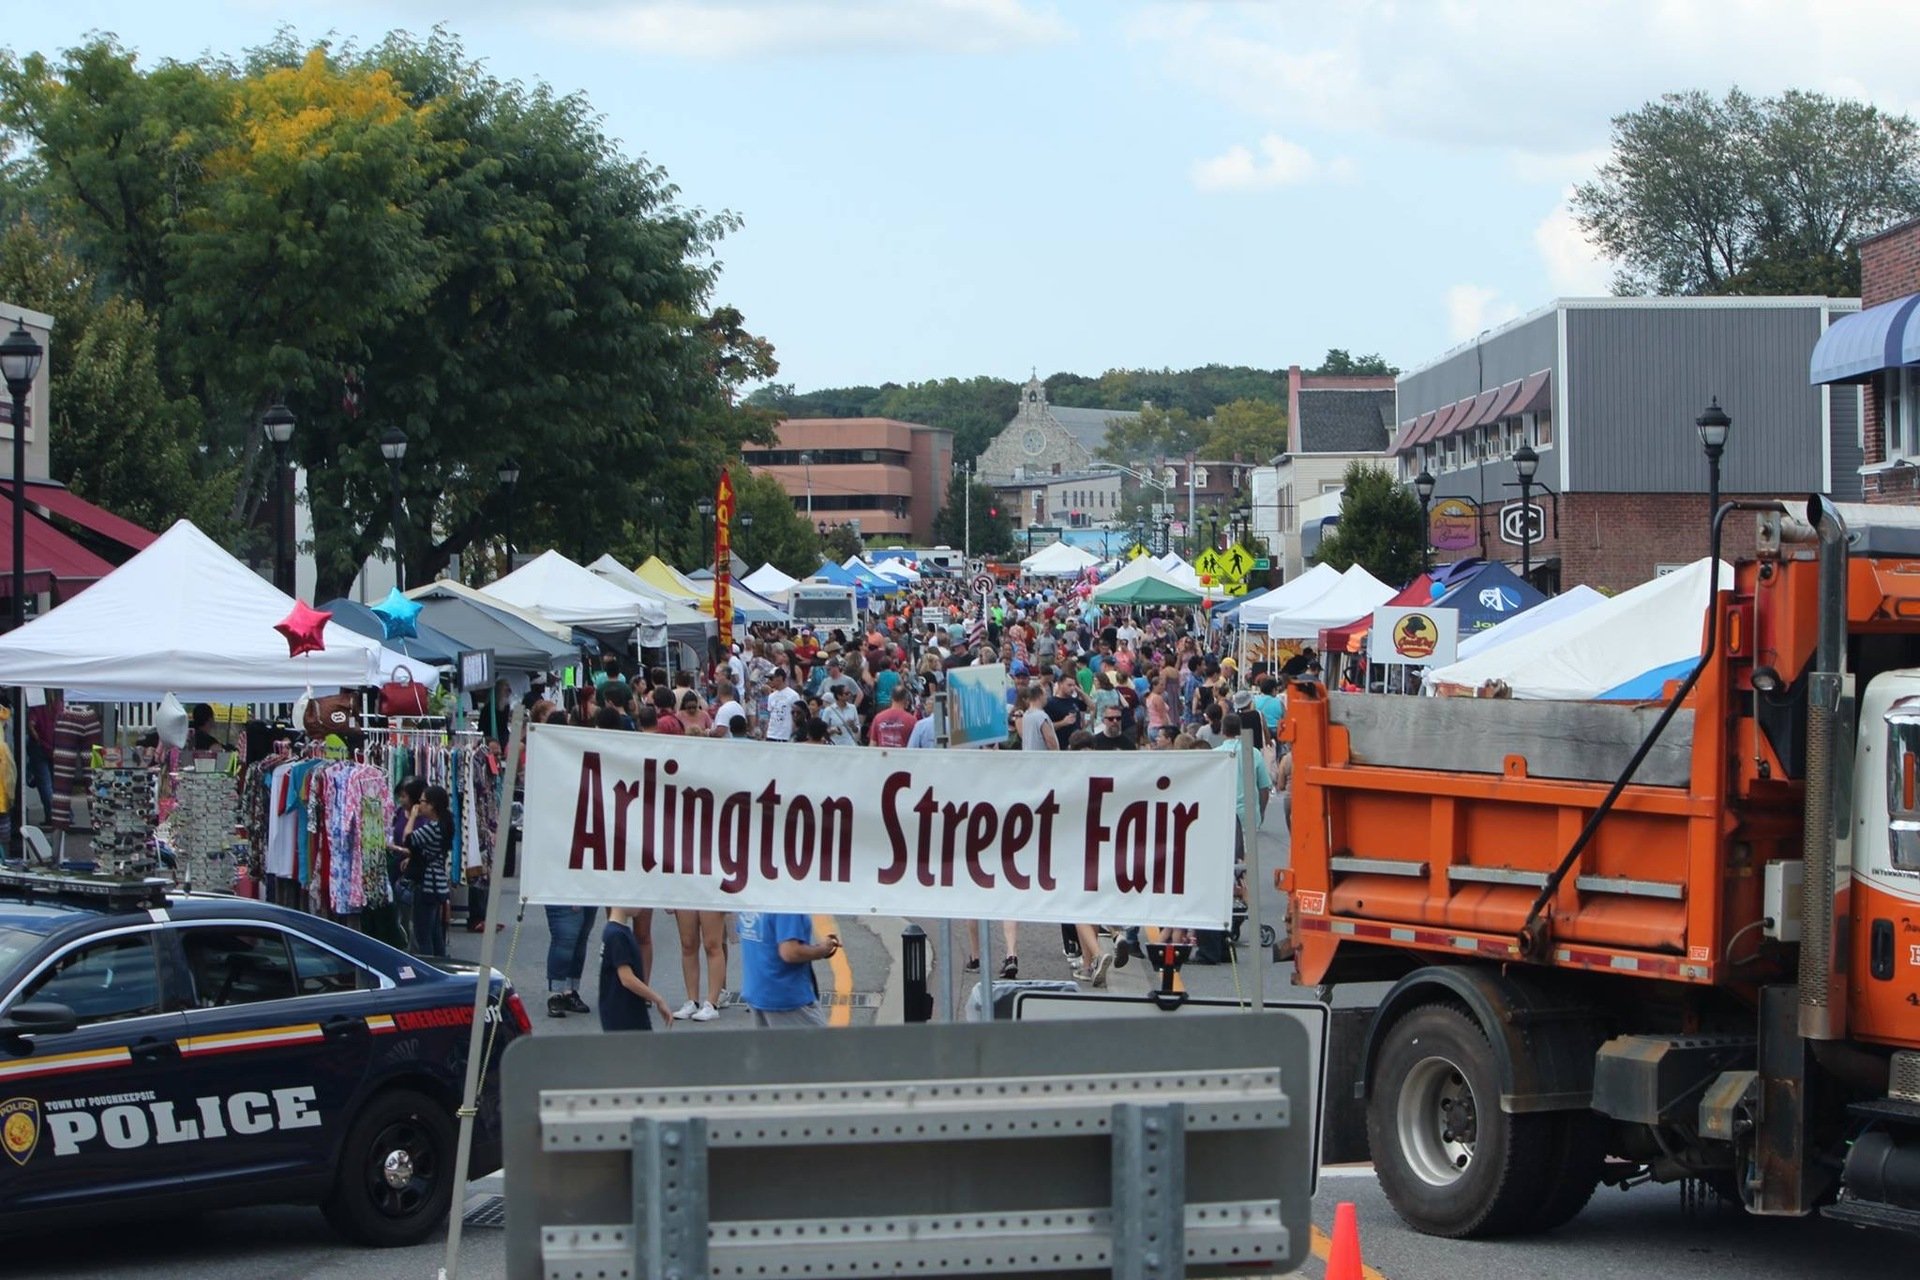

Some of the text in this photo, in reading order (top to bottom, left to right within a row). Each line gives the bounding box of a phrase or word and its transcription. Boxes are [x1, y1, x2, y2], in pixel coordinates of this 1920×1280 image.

[568, 751, 1199, 895] Arlington Street Fair
[0, 1101, 35, 1117] POLICE
[45, 1091, 156, 1111] TOWN OF POUGHKEEPSIE
[46, 1085, 322, 1156] POLICE
